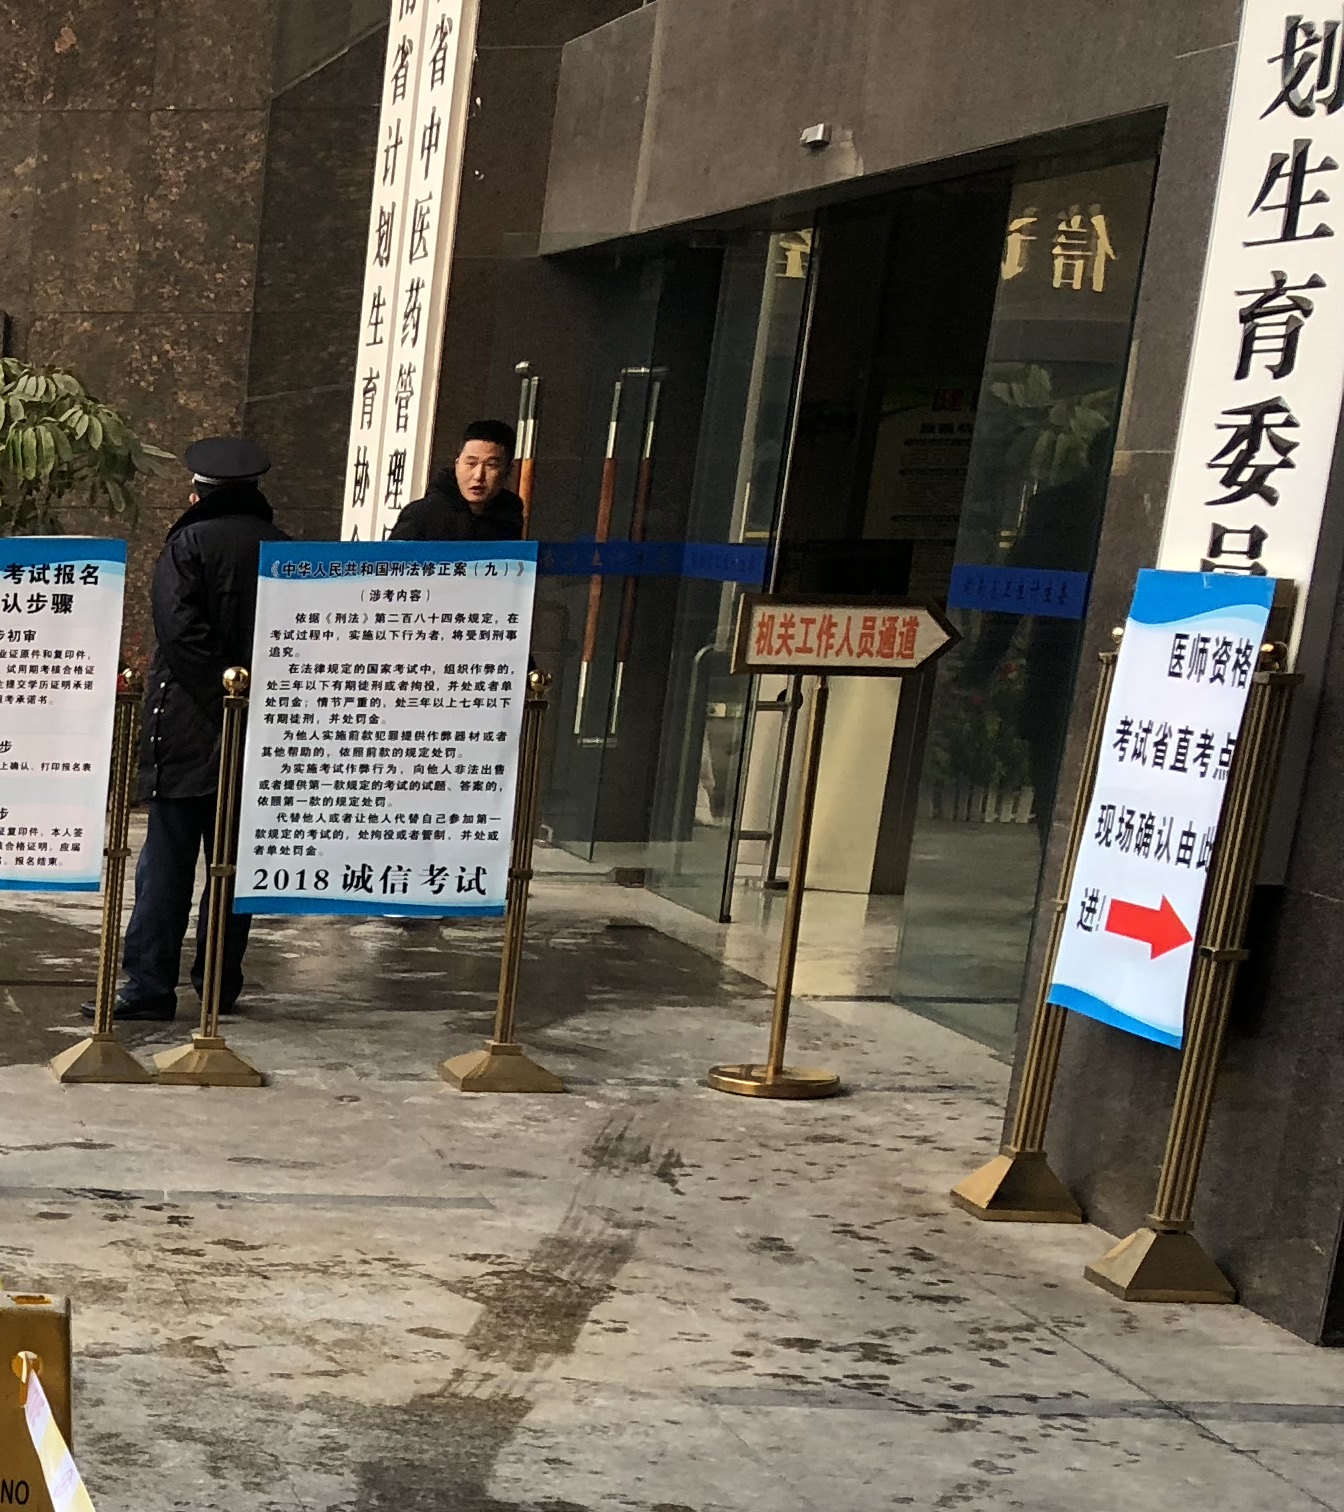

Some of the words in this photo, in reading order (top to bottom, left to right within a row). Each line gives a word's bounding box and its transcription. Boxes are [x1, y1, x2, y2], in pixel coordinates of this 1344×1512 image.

[350, 0, 417, 541] 省计划生育协
[382, 13, 454, 541] 省中医药管理
[270, 559, 526, 579] 《中华人民共和国刑法修正案（九）》
[268, 646, 301, 659] 追究。
[755, 612, 921, 661] 机关工作人员通道
[1167, 633, 1254, 691] 医师资格
[1112, 715, 1237, 781] 考试省直考点
[252, 868, 330, 892] 2018
[340, 863, 488, 896] 诚信考试
[0, 1479, 30, 1505] NO
